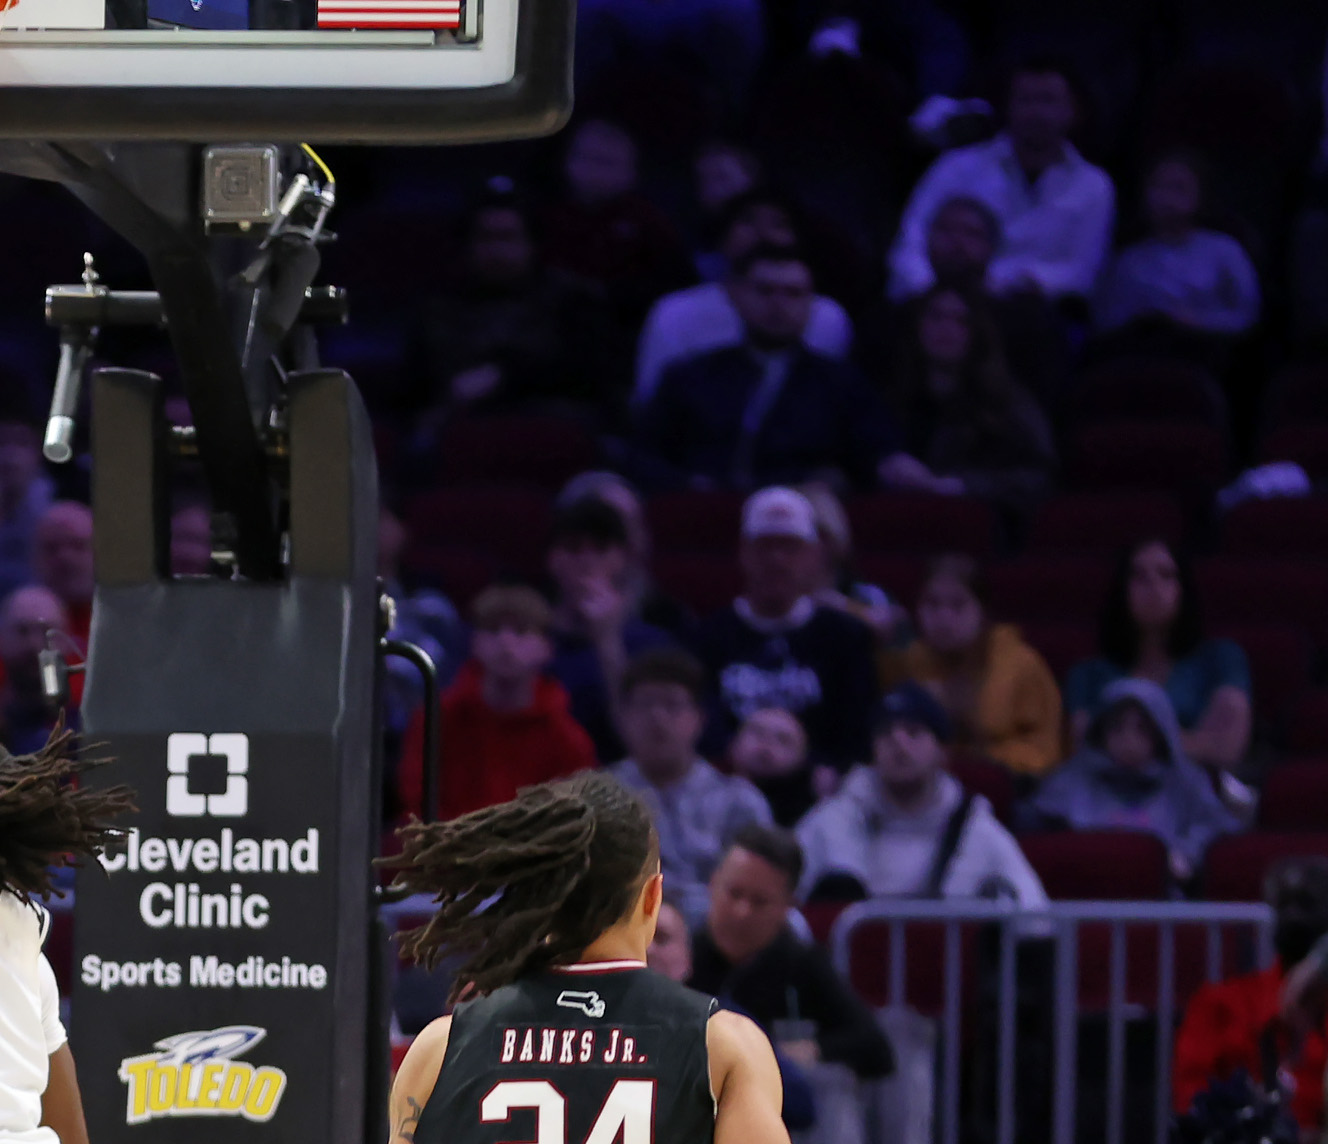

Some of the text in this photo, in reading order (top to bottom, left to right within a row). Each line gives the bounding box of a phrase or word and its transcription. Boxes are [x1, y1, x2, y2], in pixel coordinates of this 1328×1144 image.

[139, 881, 270, 929] Clinic
[80, 954, 328, 992] Sports Medicine
[500, 1028, 594, 1064] BANKS
[122, 1056, 285, 1121] TOLEDO
